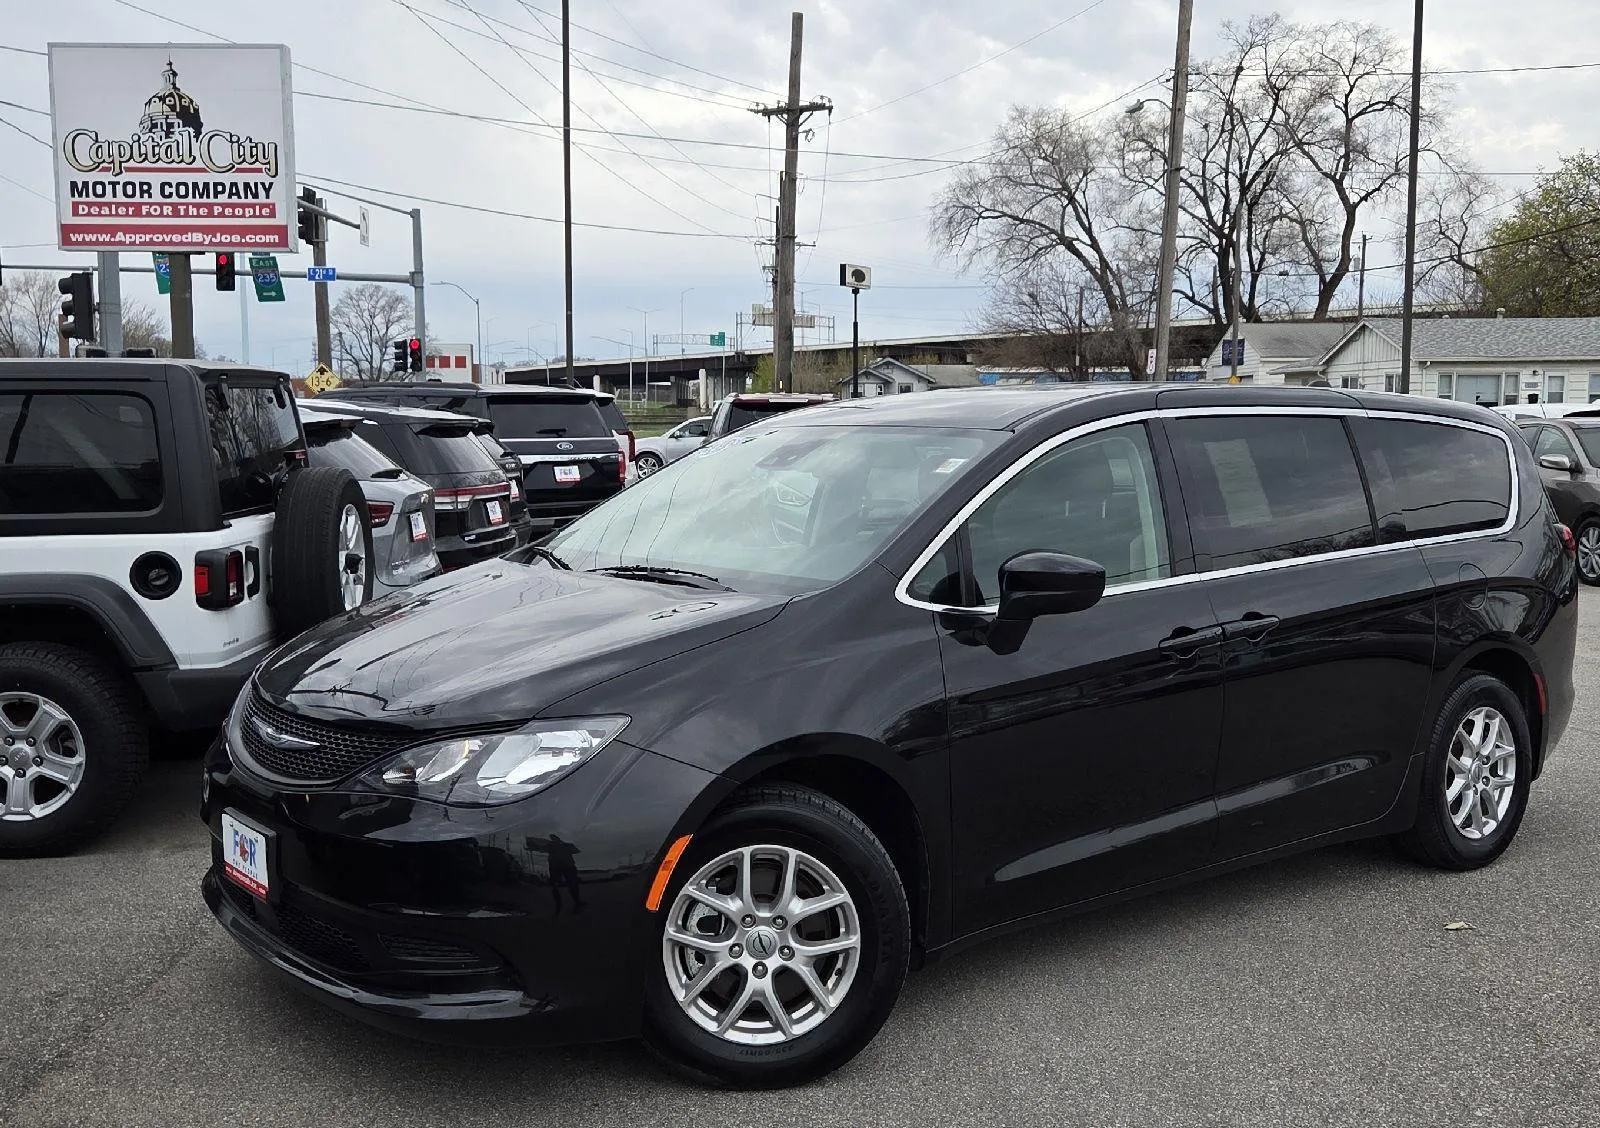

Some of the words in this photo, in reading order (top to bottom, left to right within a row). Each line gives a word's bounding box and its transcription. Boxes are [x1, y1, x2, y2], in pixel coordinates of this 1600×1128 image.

[63, 128, 196, 177] Capital
[199, 129, 279, 178] City
[69, 180, 153, 199] MOTOR
[159, 181, 274, 200] COMPANY
[78, 204, 135, 215] Dealer
[142, 205, 173, 216] FOR
[178, 204, 209, 216] The
[69, 231, 279, 245] www.ApprovedByJoe.com
[252, 259, 274, 267] EAST
[257, 273, 277, 283] 235
